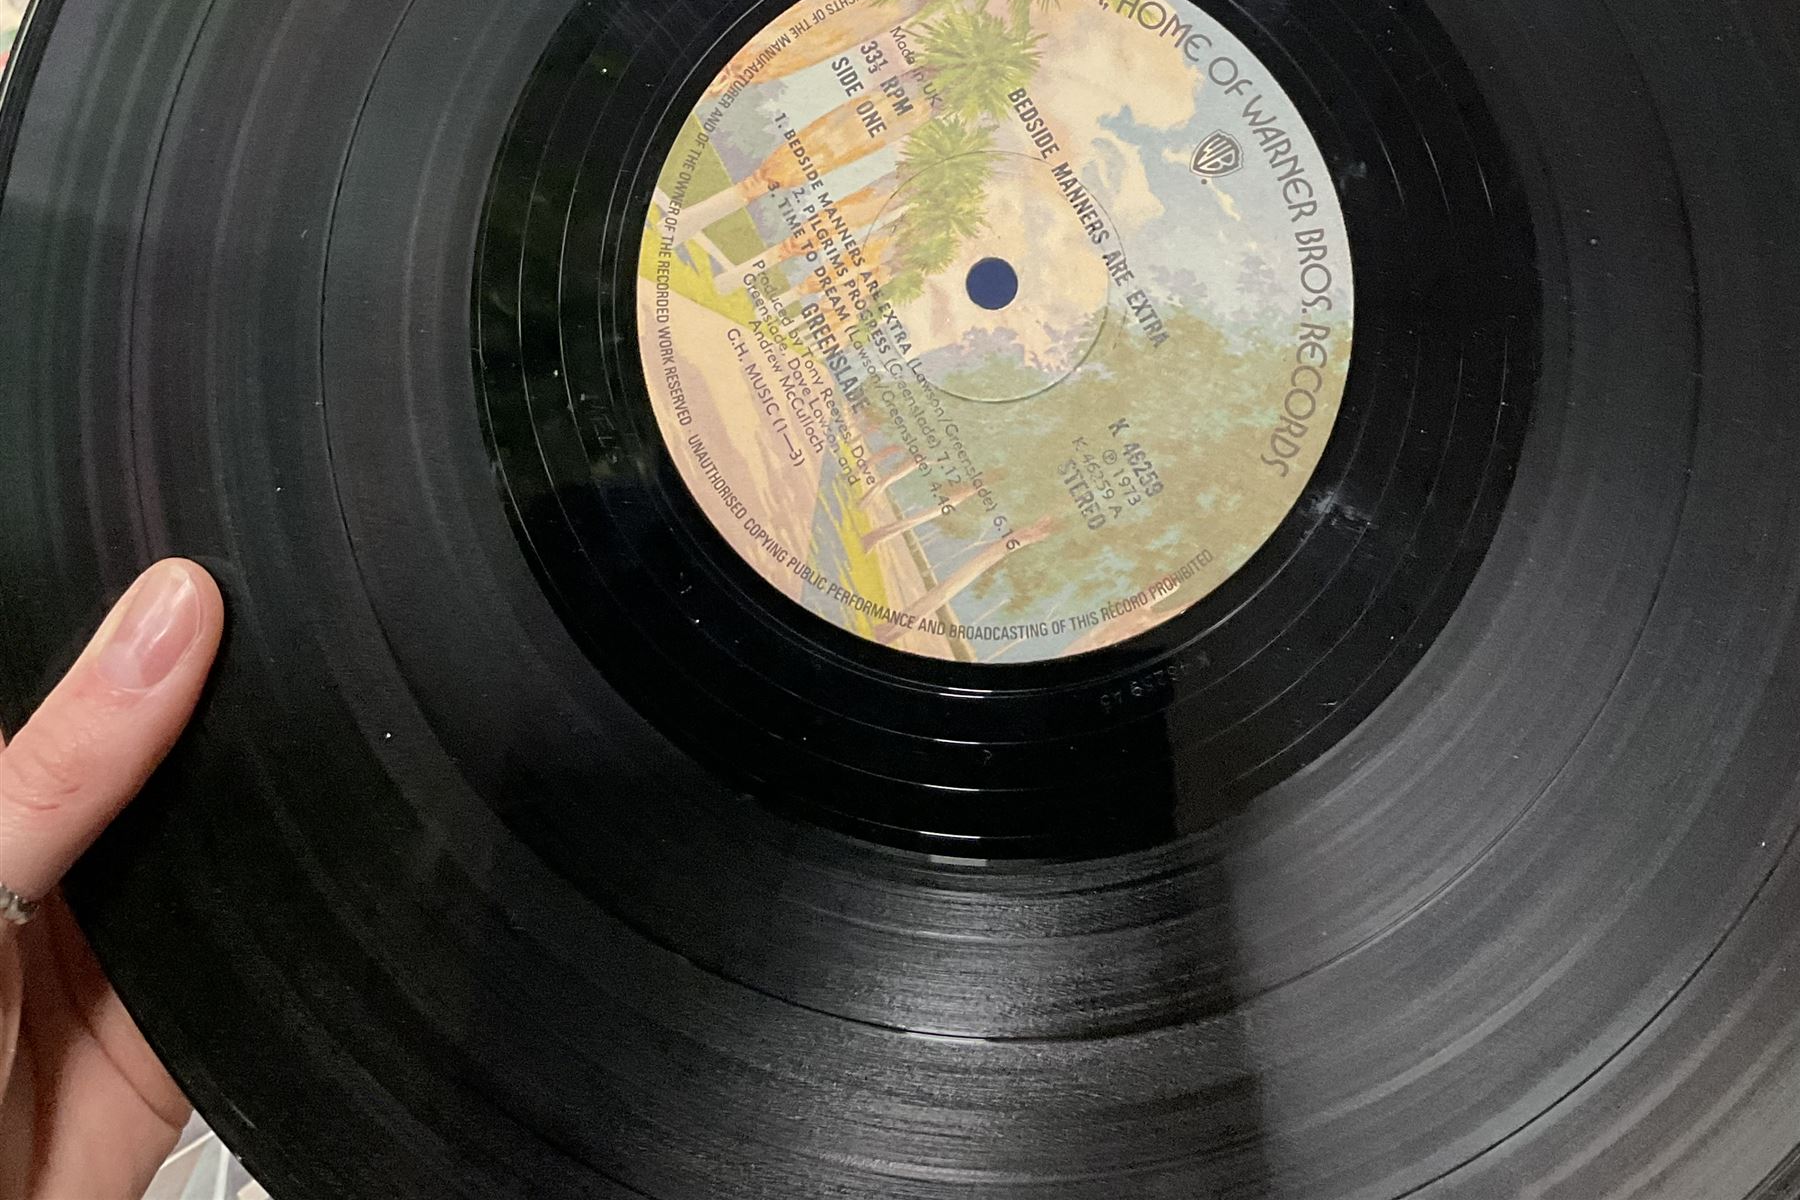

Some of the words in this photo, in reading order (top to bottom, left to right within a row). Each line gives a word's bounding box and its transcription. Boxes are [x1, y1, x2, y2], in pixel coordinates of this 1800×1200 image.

[788, 17, 812, 40] THE
[808, 7, 828, 26] OF
[717, 32, 792, 110] MANUFACTURER
[888, 25, 919, 66] Made
[919, 81, 943, 108] UK
[1202, 50, 1254, 103] OF
[700, 106, 725, 134] AND
[829, 54, 865, 98] SIDE
[854, 98, 888, 139] ONE
[878, 74, 915, 117] RPM
[681, 147, 702, 172] THE
[692, 131, 710, 150] OF
[1236, 93, 1322, 222] WARNER
[665, 170, 692, 216] OWNER
[1006, 85, 1060, 160] BEDSIDE
[1049, 160, 1111, 247] MANNERS
[1099, 246, 1135, 287] ARE
[1124, 287, 1171, 349] EXTRA
[657, 233, 674, 257] THE
[661, 215, 677, 233] OF
[654, 259, 671, 323] RECORDED
[749, 258, 795, 328] Produced
[1292, 224, 1333, 314] BROS.
[656, 326, 674, 365] WORK
[764, 179, 784, 199] 3.
[775, 198, 807, 239] TIME
[798, 238, 820, 264] TO
[812, 264, 851, 322] DREAM
[926, 479, 956, 517] 4.46
[772, 111, 790, 130] 1.
[782, 127, 825, 191] BEDSIDE
[816, 190, 867, 268] MANNERS
[858, 267, 885, 302] ARE
[876, 300, 915, 356] EXTRA
[990, 512, 1022, 552] 6.16
[784, 325, 808, 349] by
[790, 185, 809, 204] 2.
[800, 203, 850, 278] PILGRIMS
[841, 277, 892, 356] PROGRESS
[933, 450, 963, 488] 7.12
[723, 326, 752, 362] G.H.
[743, 362, 781, 416] MUSIC
[795, 348, 828, 388] Tony
[797, 300, 873, 415] GREENSLADE
[662, 365, 693, 427] RESERVED
[746, 316, 786, 375] Andrew
[777, 374, 828, 454] McCulloch
[1256, 321, 1333, 479] RECORDS
[784, 356, 816, 397] Dave
[805, 396, 845, 454] Lawson
[835, 454, 862, 487] and
[1070, 434, 1088, 452] K
[686, 432, 748, 521] UNAUTHORISED
[848, 443, 881, 486] Dave
[1077, 449, 1117, 503] 46259
[1106, 416, 1130, 438] K
[1118, 437, 1166, 500] 46259
[1053, 457, 1110, 533] STEREO
[1107, 500, 1126, 520] A
[1111, 467, 1143, 507] 1973
[741, 516, 789, 564] COPYING
[784, 555, 828, 592] PUBLIC
[1147, 547, 1216, 601] PROHIBITED
[824, 581, 915, 630] PERFORMANCE
[915, 617, 946, 637] AND
[1050, 618, 1069, 636] OF
[1067, 609, 1100, 632] THIS
[1099, 590, 1150, 623] RECORD
[949, 622, 1048, 640] BROADCASTING
